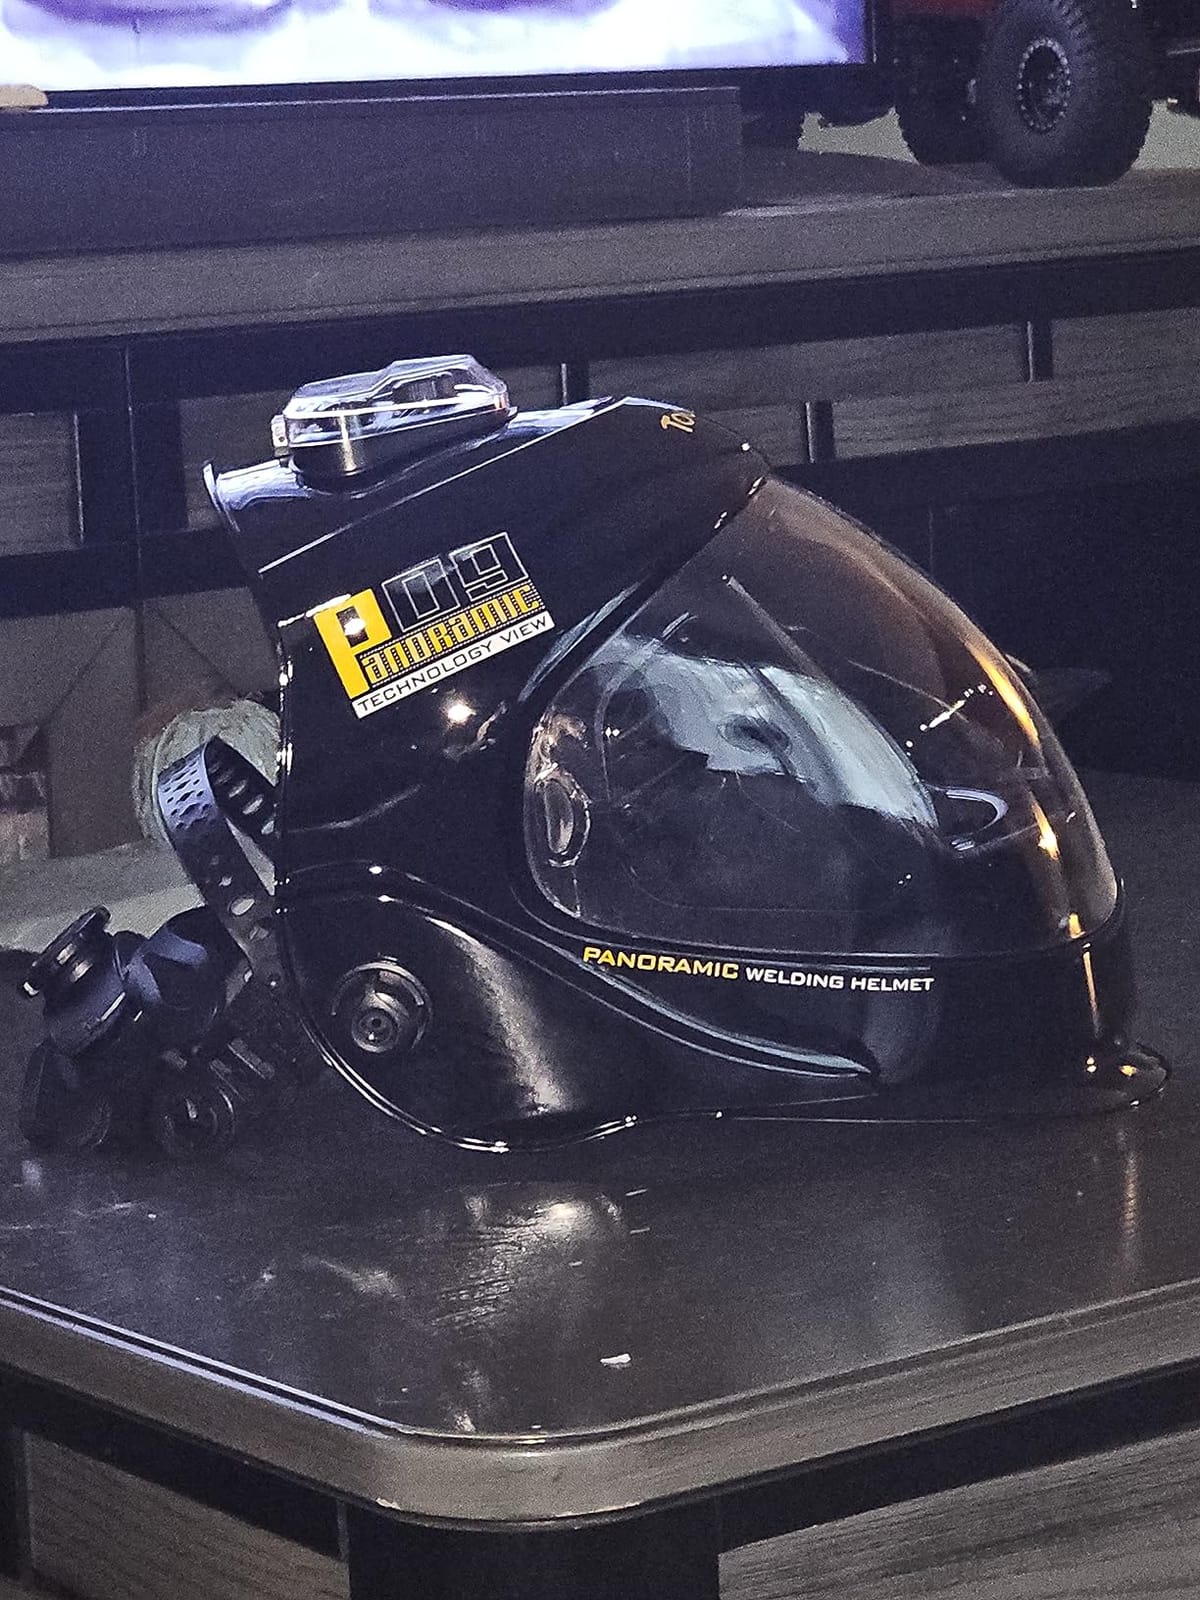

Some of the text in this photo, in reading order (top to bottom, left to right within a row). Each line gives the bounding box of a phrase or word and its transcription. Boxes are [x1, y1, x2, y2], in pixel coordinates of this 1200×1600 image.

[357, 615, 547, 712] TECHNOLOGY VIEW
[583, 946, 935, 993] PANORAMIC WELDING HELMET
